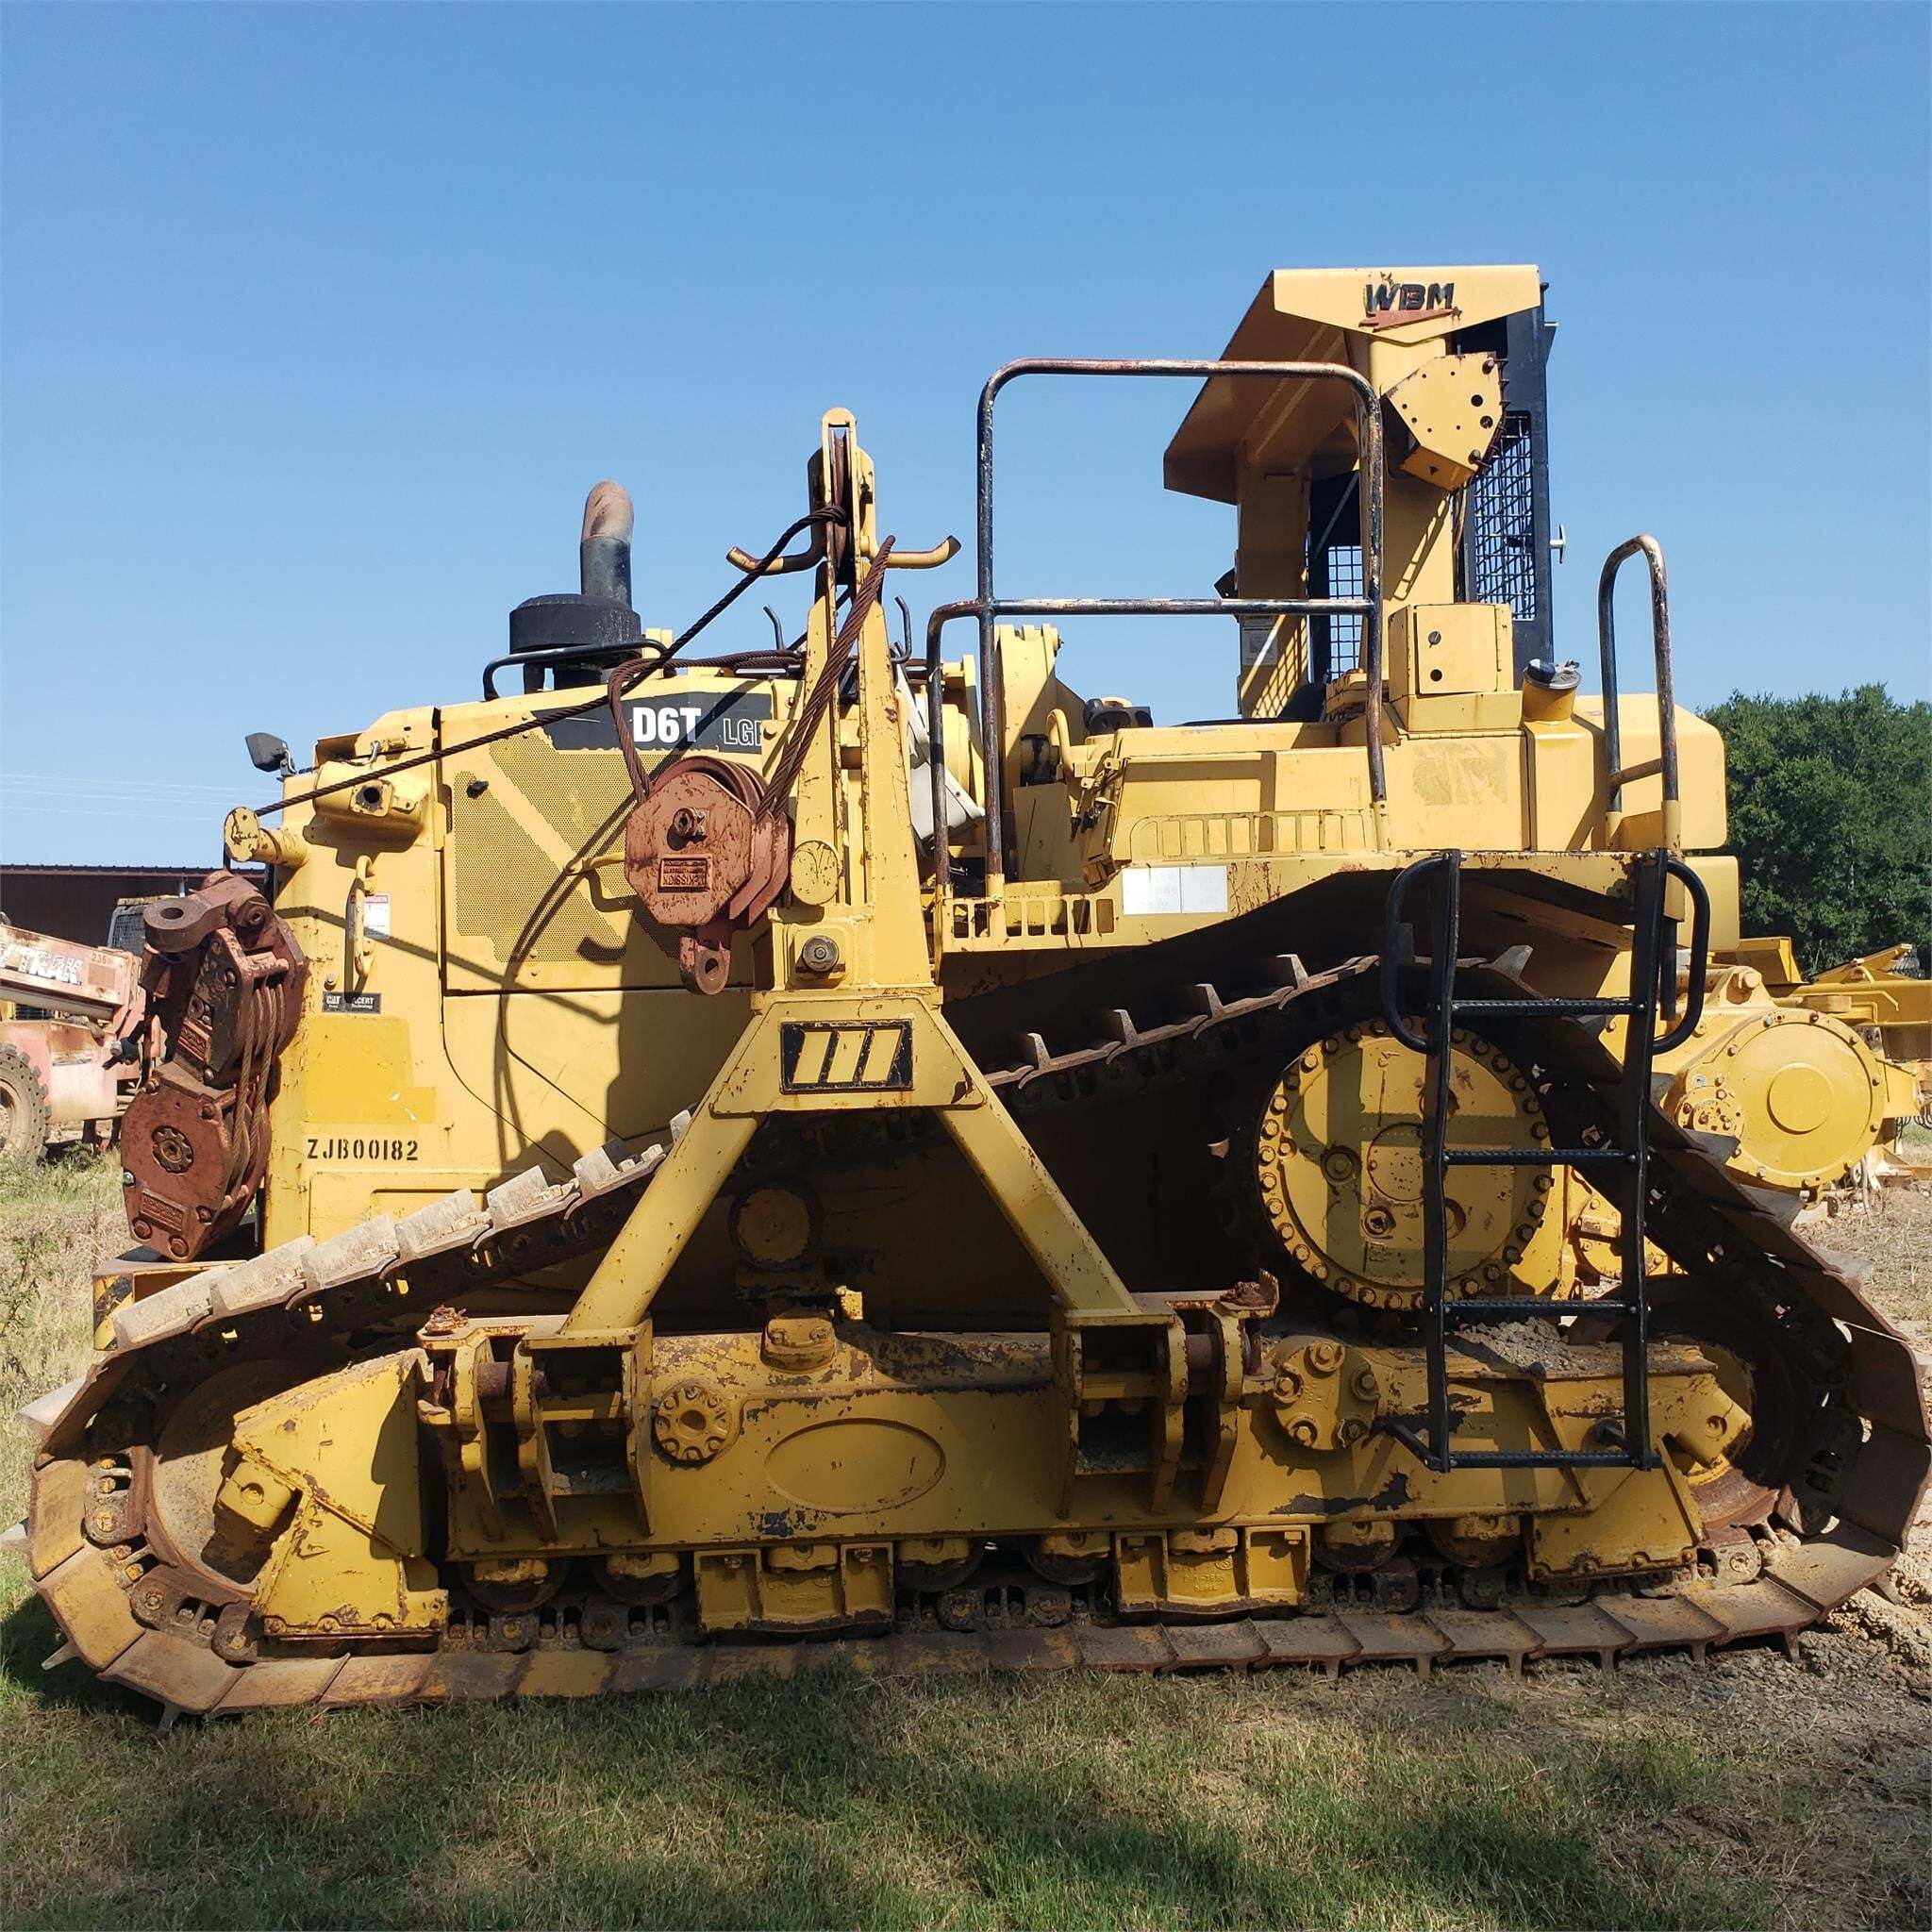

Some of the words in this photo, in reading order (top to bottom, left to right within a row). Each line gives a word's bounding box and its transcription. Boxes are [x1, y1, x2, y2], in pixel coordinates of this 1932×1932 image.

[1365, 282, 1455, 314] WBM
[633, 707, 702, 742] D6T
[307, 1139, 418, 1161] ZJB00182
